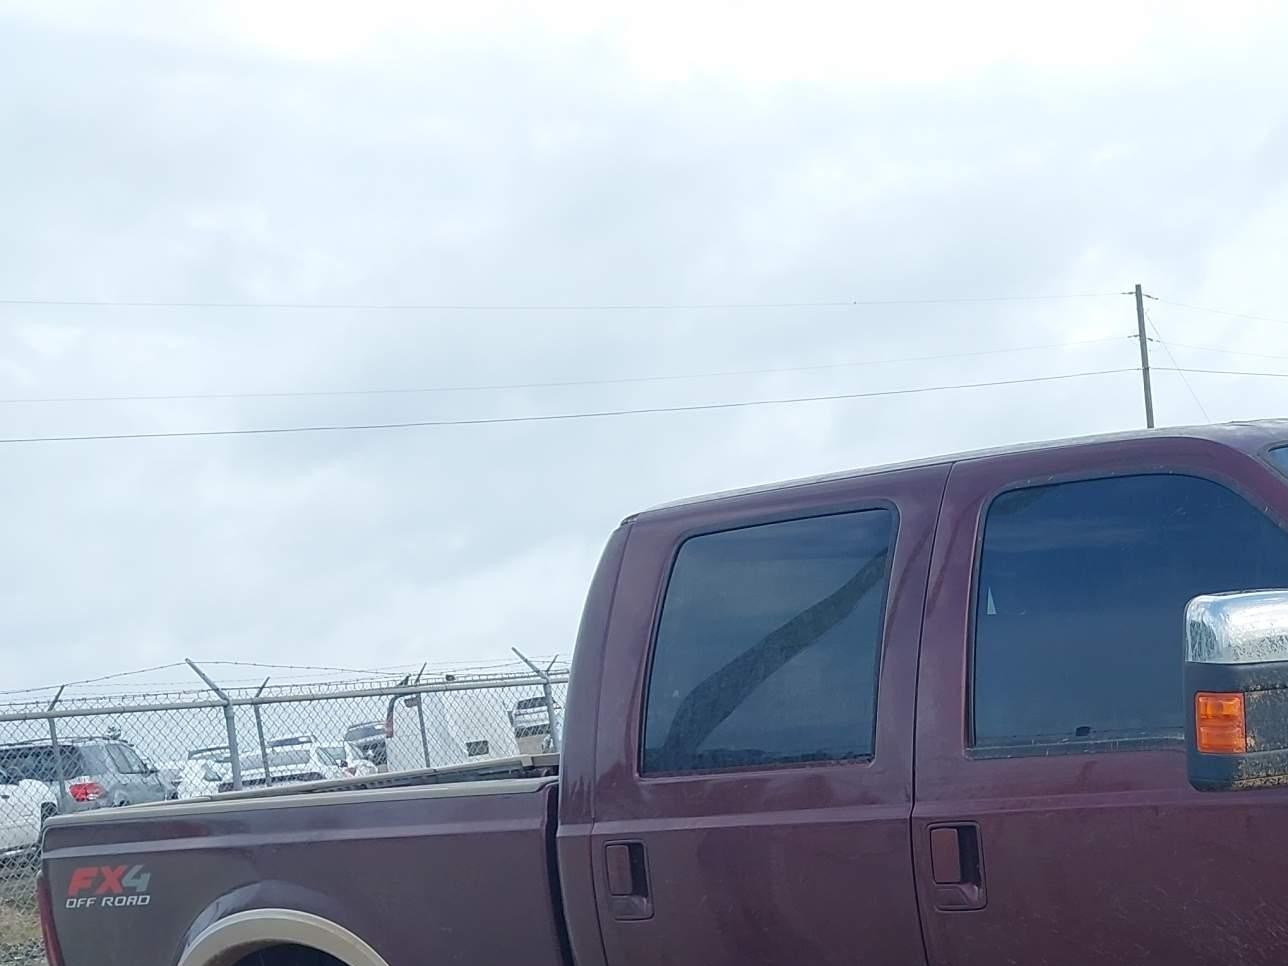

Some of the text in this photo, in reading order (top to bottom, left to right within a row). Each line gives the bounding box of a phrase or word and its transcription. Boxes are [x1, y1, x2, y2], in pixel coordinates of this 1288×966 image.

[67, 864, 151, 896] FX4
[65, 895, 151, 909] OFF ROAD
